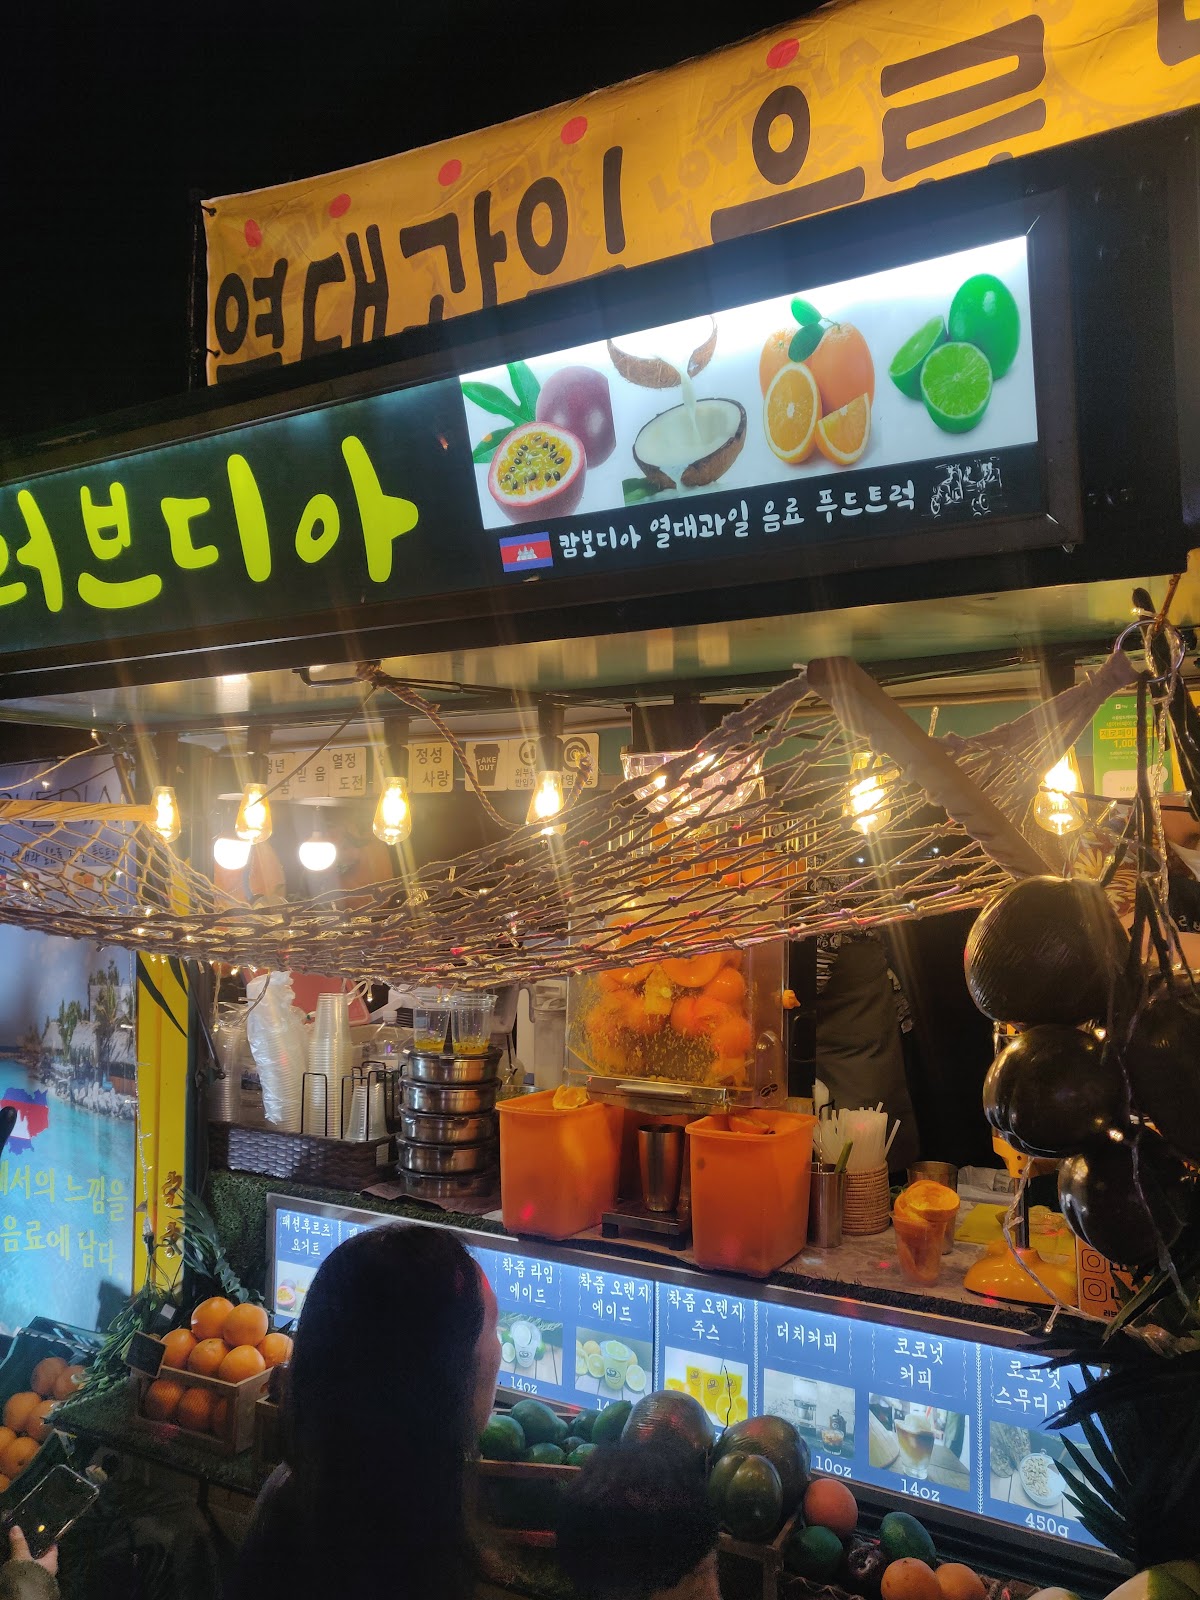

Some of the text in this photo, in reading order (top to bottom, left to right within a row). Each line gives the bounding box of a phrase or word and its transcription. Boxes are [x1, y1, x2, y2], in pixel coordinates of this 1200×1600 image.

[559, 479, 915, 558] 캄보디아 열대과일 음료 푸드트럭
[332, 752, 356, 770] 열정
[416, 747, 442, 765] 정성
[477, 756, 497, 766] TAKE
[338, 774, 363, 791] 도전
[423, 769, 450, 788] 사랑
[64, 1175, 129, 1222] 느낌을
[0, 1214, 70, 1261] 음료에
[291, 1238, 321, 1256] 요거트
[502, 1256, 554, 1284] 착즙 라임
[509, 1281, 546, 1304] 에이드
[580, 1272, 650, 1304] 착즙 오렌지
[592, 1299, 632, 1322] 에이드
[669, 1289, 744, 1324] 착즙 오렌지
[691, 1320, 720, 1341] 주스
[776, 1321, 838, 1355] 더치커피
[894, 1337, 944, 1366] 코코넛
[510, 1376, 538, 1395] 14oz
[900, 1364, 933, 1392] 커피
[994, 1386, 1048, 1418] 스무디
[815, 1455, 853, 1479] 10oz
[900, 1478, 941, 1503] 14oz
